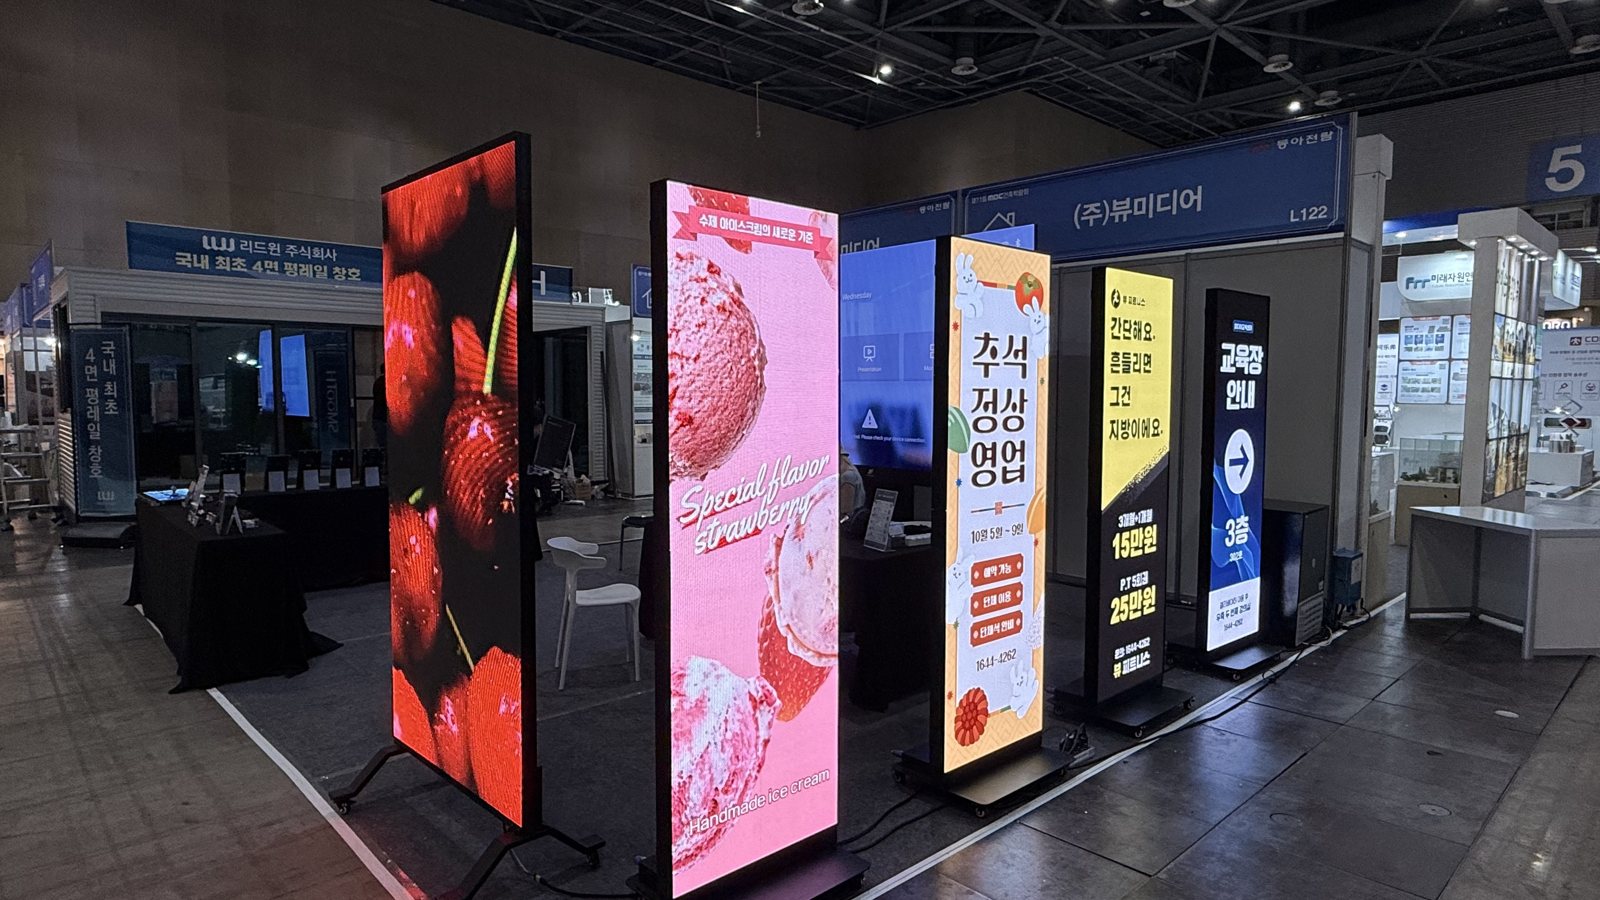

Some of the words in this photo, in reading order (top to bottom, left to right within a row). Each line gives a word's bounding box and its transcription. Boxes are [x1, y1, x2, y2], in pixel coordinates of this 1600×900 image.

[1544, 144, 1585, 192] 5
[1074, 186, 1202, 229] (주)뷰미디어
[1290, 206, 1328, 222] L122
[699, 214, 718, 228] 수제
[720, 216, 770, 236] 아이스크림의
[772, 226, 796, 241] 새로운
[798, 230, 814, 244] 기준
[175, 252, 210, 270] 국내
[215, 256, 248, 272] 최초
[252, 260, 279, 276] 4면
[284, 262, 328, 280] 평레일
[333, 267, 362, 282] 창호
[239, 240, 281, 257] 리드윈
[284, 244, 338, 262] 주식회사
[1110, 317, 1156, 342] 간단해요.
[85, 348, 98, 382] 4면
[101, 341, 116, 376] 국내
[972, 332, 1028, 379] 추석
[1110, 352, 1152, 374] 흔들리면
[1220, 342, 1264, 375] 교육장
[104, 381, 118, 415] 최초
[971, 388, 1028, 434] 정상
[1110, 386, 1130, 406] 그건
[1226, 380, 1256, 410] 안내
[1109, 418, 1163, 440] 지방이에요.
[971, 440, 1026, 488] 영업
[679, 463, 768, 531] Special
[768, 455, 830, 505] flavor
[695, 494, 813, 555] strawberry
[971, 528, 988, 544] 10월
[990, 526, 1003, 540] 5일
[1012, 523, 1024, 537] 9일
[1225, 515, 1250, 547] 3층
[1112, 524, 1158, 560] 15만원
[998, 562, 1012, 575] 가능
[1120, 577, 1132, 592] P.T
[983, 594, 998, 609] 단체
[998, 590, 1012, 604] 이용
[1110, 585, 1156, 625] 25만원
[976, 649, 1016, 672] 1644-4262
[689, 794, 766, 835] Handmade
[768, 786, 788, 804] ice
[790, 769, 830, 794] cream
